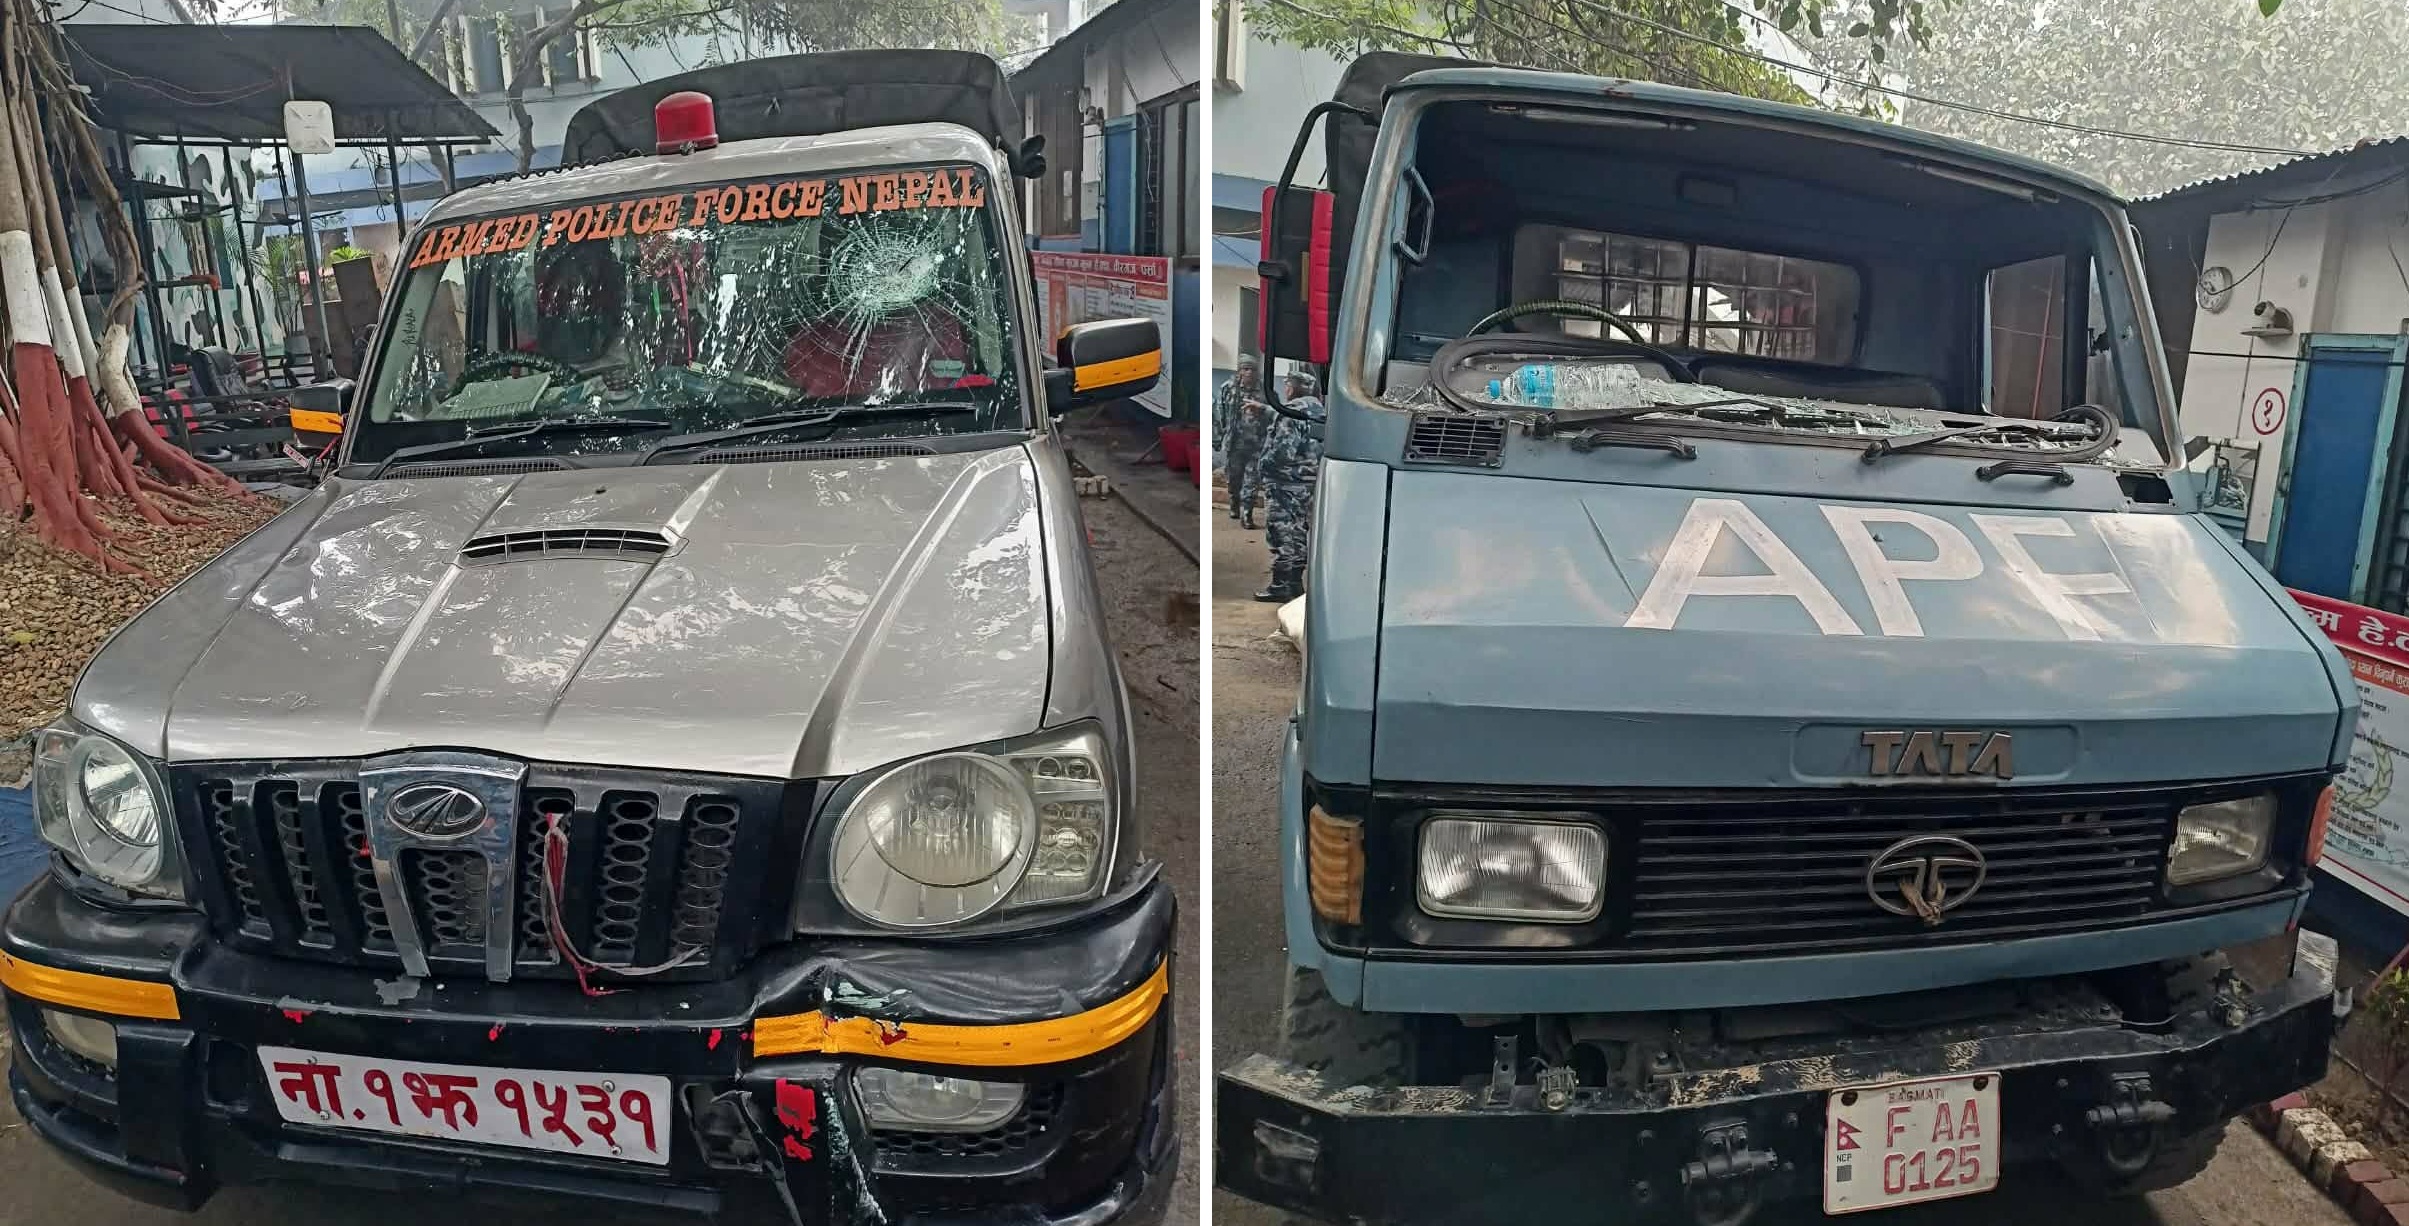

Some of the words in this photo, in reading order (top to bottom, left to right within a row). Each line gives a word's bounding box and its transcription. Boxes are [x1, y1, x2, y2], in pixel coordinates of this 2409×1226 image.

[409, 218, 538, 269] ARMED
[544, 193, 681, 248] POLICE
[690, 179, 826, 226] FORCE
[839, 168, 984, 215] NEPAL
[1624, 498, 2134, 642] APF
[1862, 730, 2014, 780] TATA
[494, 1078, 656, 1155] १५३१
[1887, 1106, 1911, 1147] F
[1931, 1099, 1981, 1142] AA
[1836, 1153, 1852, 1162] NEP
[1884, 1144, 1981, 1194] 0125
